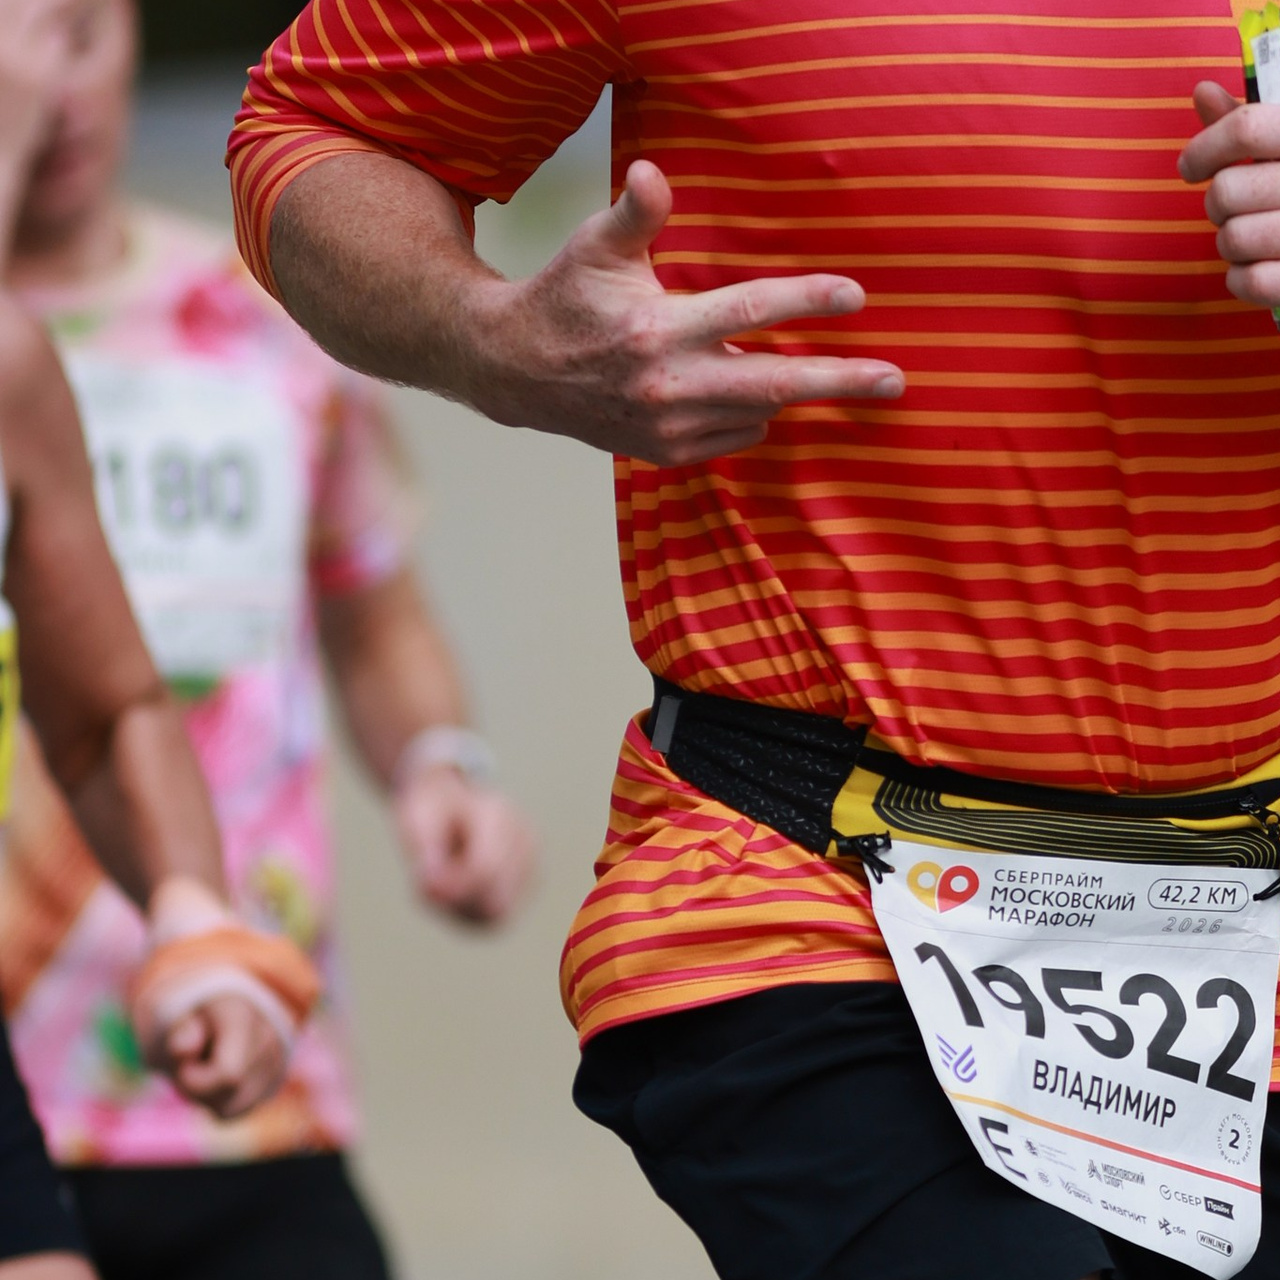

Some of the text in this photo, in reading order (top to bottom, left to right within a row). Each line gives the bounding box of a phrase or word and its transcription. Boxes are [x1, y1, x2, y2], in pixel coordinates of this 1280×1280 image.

[994, 868, 1103, 889] СБЕРПРАЙМ
[990, 886, 1136, 912] МОСКОВСКИЙ
[1159, 885, 1201, 906] 42,2
[988, 905, 1095, 929] МАРАФОН
[914, 941, 1257, 1103] 19522
[1032, 1058, 1177, 1128] ВЛАДИМИР
[1229, 1128, 1240, 1149] 2
[1174, 1191, 1202, 1206] СБЕР
[1199, 1234, 1227, 1251] WINLINE
